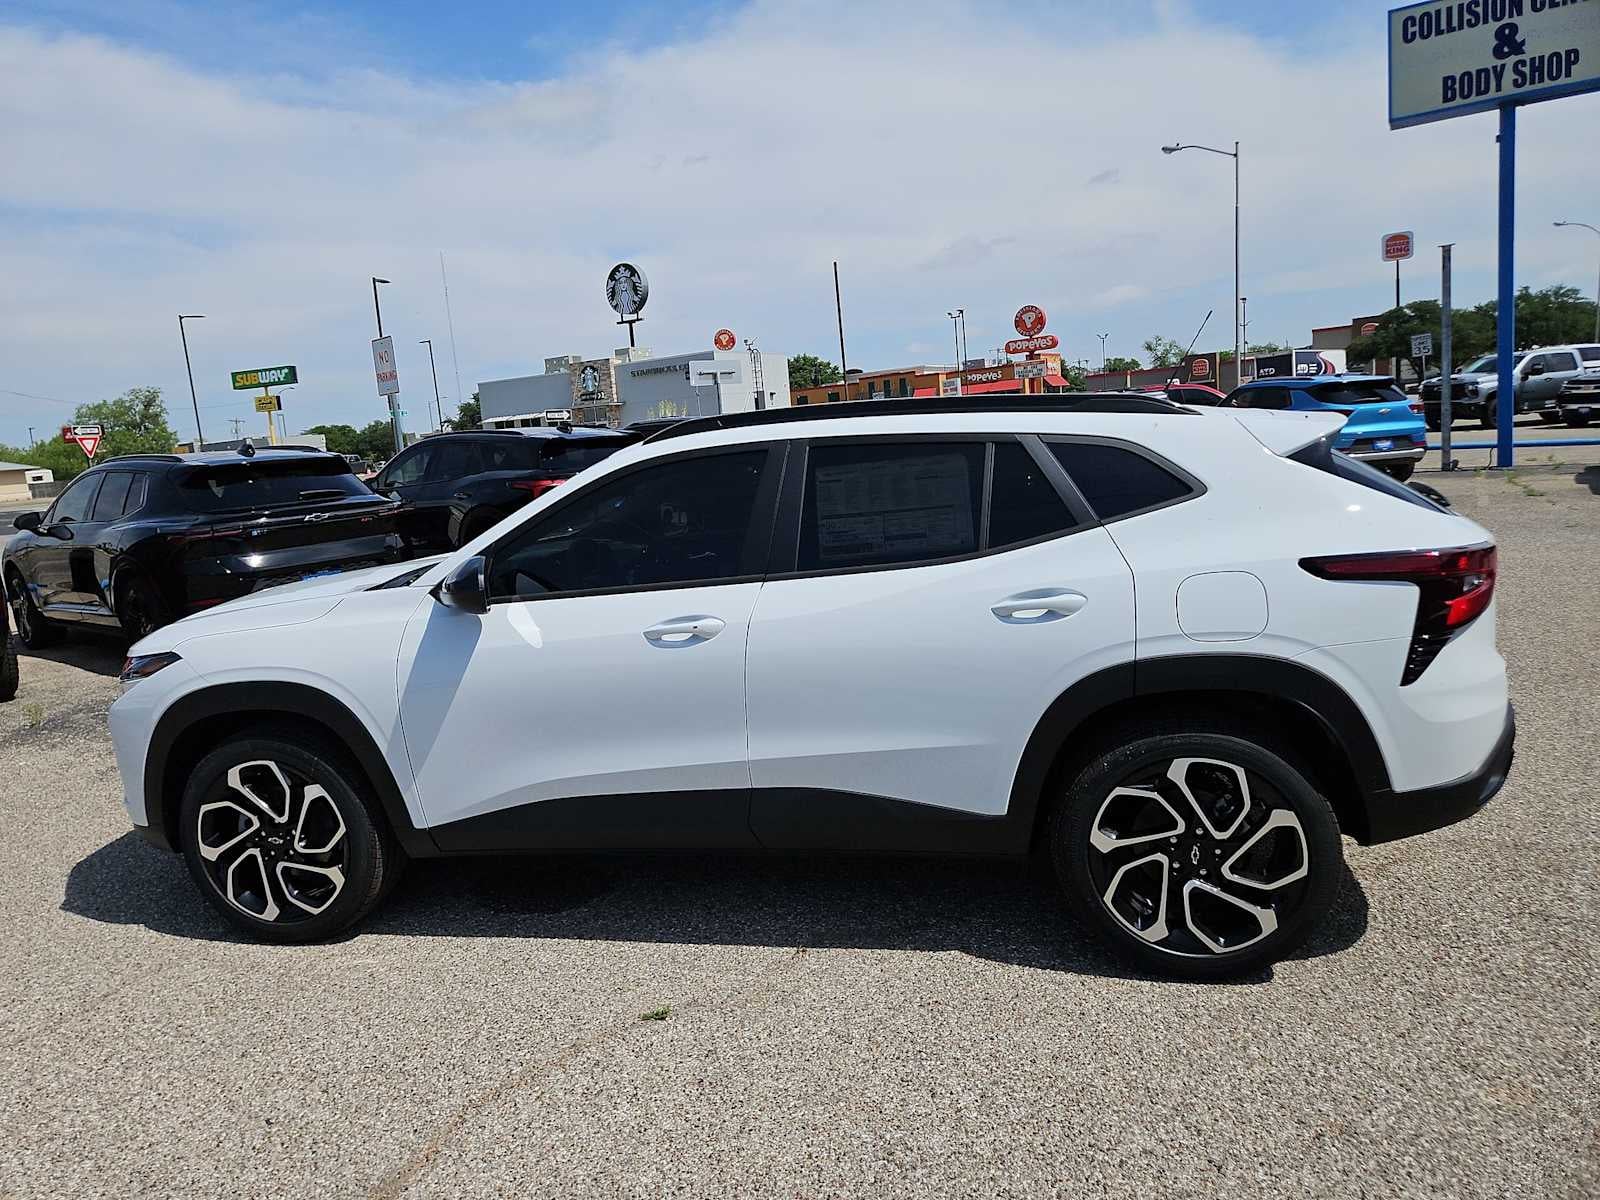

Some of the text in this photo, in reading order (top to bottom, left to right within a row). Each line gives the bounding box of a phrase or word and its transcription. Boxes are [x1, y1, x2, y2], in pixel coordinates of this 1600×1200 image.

[1402, 0, 1523, 44] COLLISION
[1492, 22, 1526, 60] &
[1442, 48, 1580, 103] BODY SHOP
[377, 350, 389, 364] NO
[235, 368, 287, 386] SUBWAY
